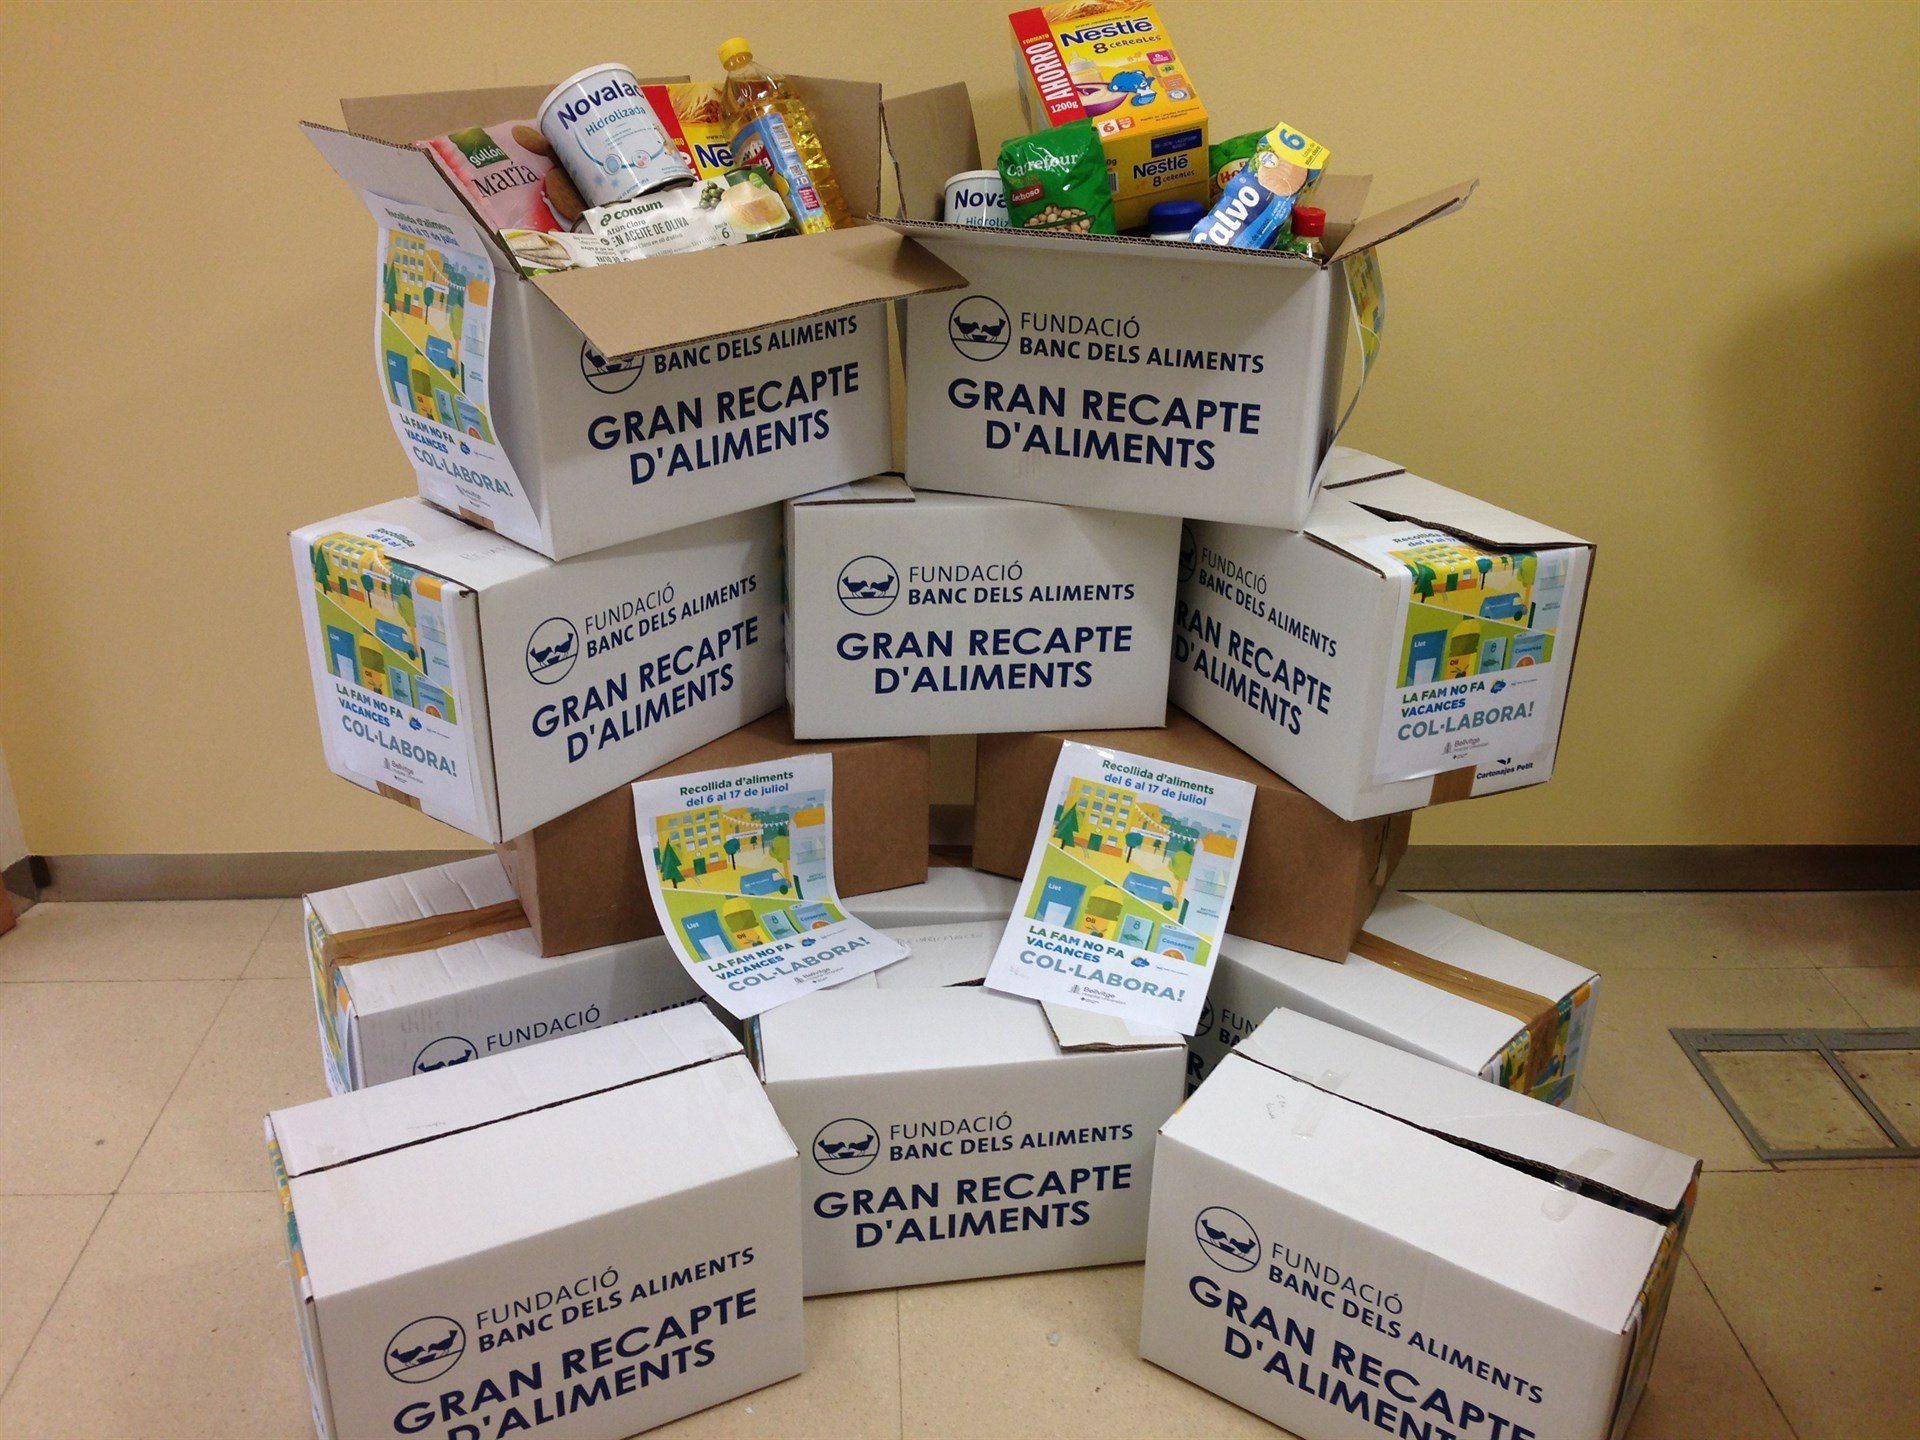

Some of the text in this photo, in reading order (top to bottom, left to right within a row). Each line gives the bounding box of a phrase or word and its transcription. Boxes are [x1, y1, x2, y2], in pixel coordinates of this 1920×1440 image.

[1022, 33, 1050, 44] FORMATO
[1092, 42, 1109, 54] 8
[1025, 41, 1075, 101] AHORRO
[557, 79, 645, 130] Novalac
[584, 105, 646, 137] Hidrolizada
[1050, 100, 1079, 114] 1200g
[469, 145, 505, 166] gullón
[1279, 128, 1306, 150] 6
[471, 161, 541, 199] María
[1007, 154, 1078, 177] Carrefour
[1152, 176, 1162, 187] 8
[614, 200, 664, 220] consum
[954, 189, 1007, 210] Nova
[625, 223, 654, 242] ACEITE
[652, 222, 666, 235] DE
[664, 216, 690, 232] OLIVA
[721, 227, 730, 239] 6
[966, 216, 1009, 228] Hidroliz
[1020, 312, 1140, 338] FUNDACIÓ
[655, 315, 857, 374] BANC DELS ALIMENTS
[1020, 337, 1264, 373] BANC DELS ALIMENTS
[588, 362, 859, 450] GRAN RECAPTE
[948, 378, 1260, 434] GRAN RECAPTE
[405, 428, 448, 454] VACANCES
[630, 409, 830, 485] D'ALIMENTS
[986, 420, 1215, 471] D'ALIMENTS
[909, 560, 1023, 583] FUNDACIÓ
[1202, 547, 1267, 594] FUNDACIÓ
[585, 582, 674, 635] FUNDACIÓ
[908, 583, 1135, 605] BANC DELS ALIMENTS
[587, 575, 756, 658] BANC DELS ALIMENTS
[1199, 568, 1337, 658] BANC DELS ALIMENTS
[836, 625, 1132, 661] GRAN RECAPTE
[1176, 600, 1331, 715] RAN RECAPTE
[532, 616, 758, 738] GRAN RECAPTE
[875, 661, 1093, 694] D'ALIMENTS
[1174, 634, 1302, 736] D'ALIMENTS
[1402, 681, 1486, 705] LA FAM NO FA
[336, 683, 404, 720] LA FAM NO FA
[339, 697, 390, 727] VACANCES
[567, 663, 734, 764] D'ALIMENTS
[1401, 698, 1466, 718] VACANCES
[680, 771, 794, 797] Recollida d'aliments
[686, 783, 789, 807] del 6 al 17 de juliol
[1102, 759, 1215, 795] Recollida d'aliments
[1104, 773, 1207, 806] del 6 al 17 de juliol
[1048, 882, 1062, 892] Llet
[708, 942, 795, 972] LA FAM NO FA
[1026, 936, 1101, 964] VACANCES
[1029, 925, 1125, 959] LA FAM NO FA
[716, 955, 785, 980] VACANCES
[1019, 950, 1186, 1003] COL·LABORA!
[487, 1004, 600, 1051] FUNDACIÓ
[890, 1111, 1012, 1140] FUNDACIÓ
[890, 1124, 1134, 1161] BANC DELS ALIMENTS
[813, 1163, 1132, 1219] GRAN RECAPTE
[856, 1200, 1090, 1249] D'ALIMENTS
[1272, 1242, 1403, 1316] FUNDACIÓ
[476, 1266, 619, 1330] FUNDACIÓ
[479, 1247, 755, 1353] BANC DELS ALIMENTS
[1189, 1275, 1316, 1356] GRAN
[1268, 1264, 1543, 1404] BANC DELS ALIMENTS
[393, 1288, 757, 1435] GRAN RECAPTE
[1225, 1326, 1462, 1440] D'ALIMEN
